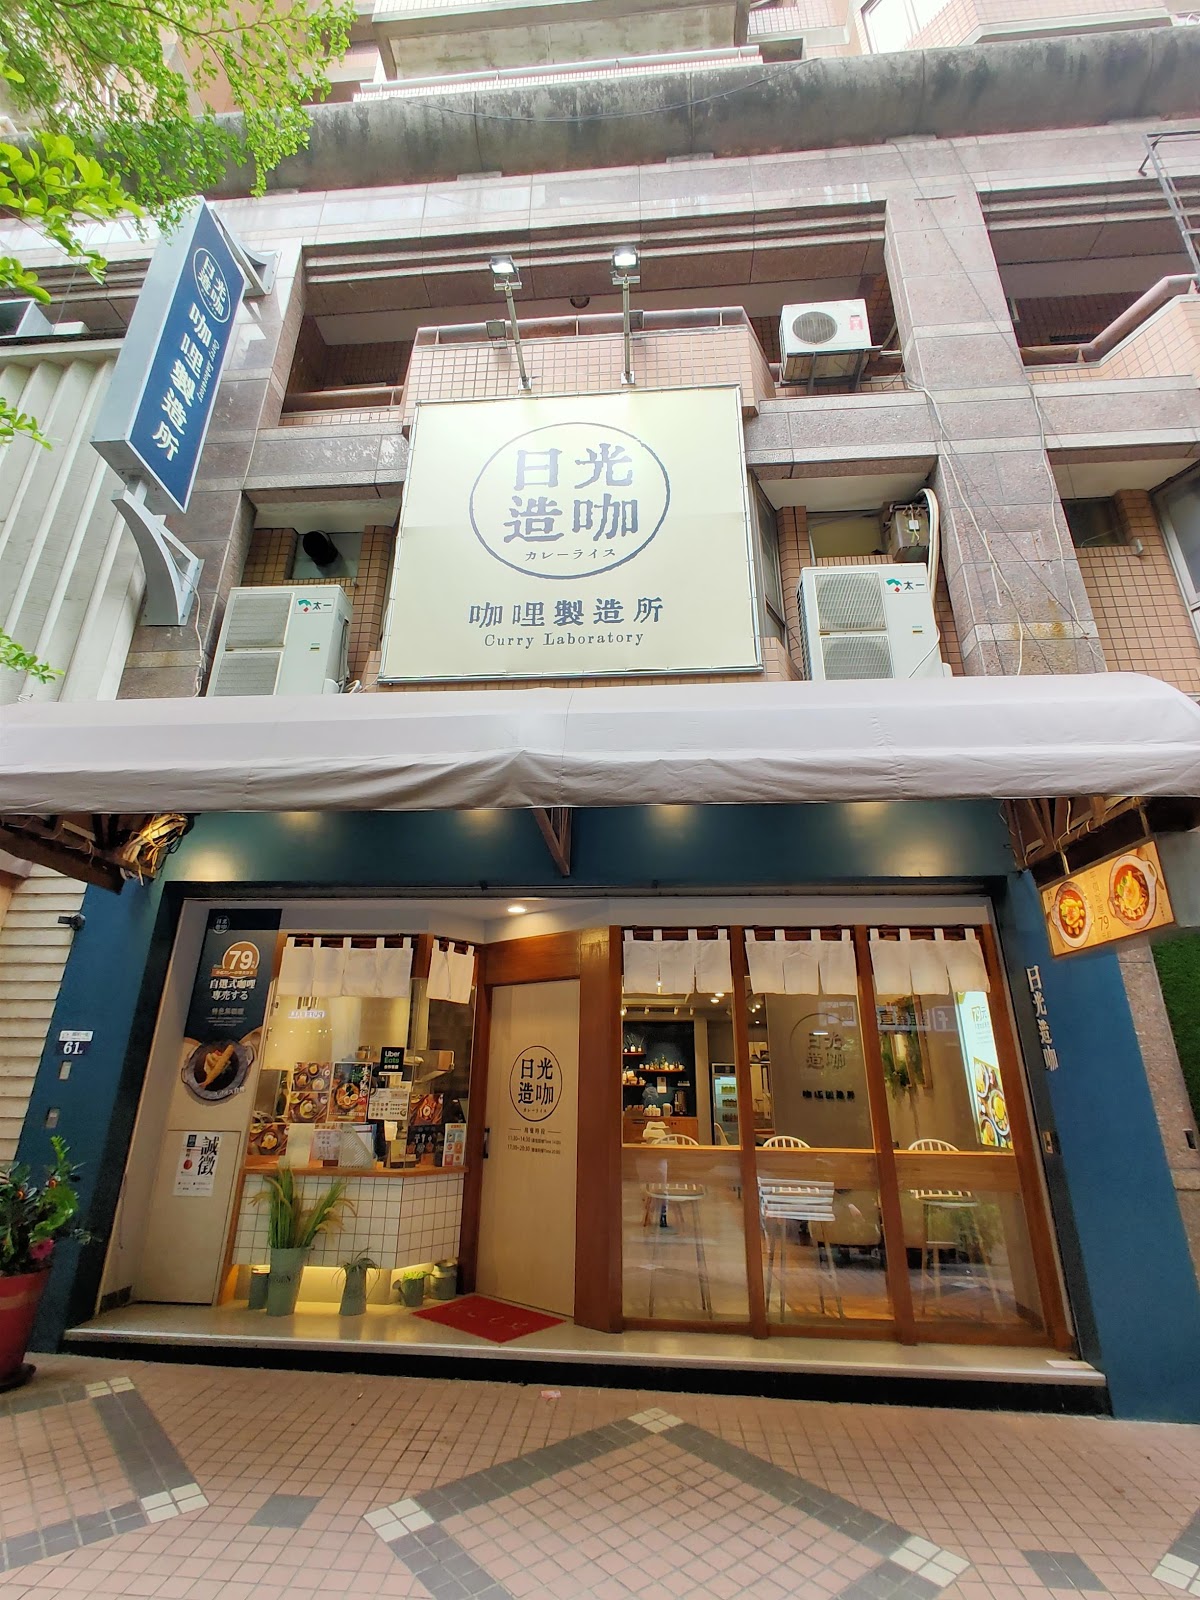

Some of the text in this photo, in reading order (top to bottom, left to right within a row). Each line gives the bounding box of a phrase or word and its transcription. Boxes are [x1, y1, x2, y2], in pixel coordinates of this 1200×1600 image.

[152, 301, 212, 462] 咖哩製造所
[197, 339, 220, 403] Curry Laboratory
[513, 443, 633, 492] 日光
[503, 493, 639, 543] 造咖
[525, 548, 616, 561] カレーライス
[469, 597, 663, 628] 咖哩製造所
[484, 631, 644, 649] Curry Laboratory
[1098, 915, 1110, 931] 79
[229, 950, 253, 970] 79
[1026, 965, 1059, 1072] 日光造咖
[520, 1057, 553, 1080] 日光
[517, 1082, 554, 1105] 造咖
